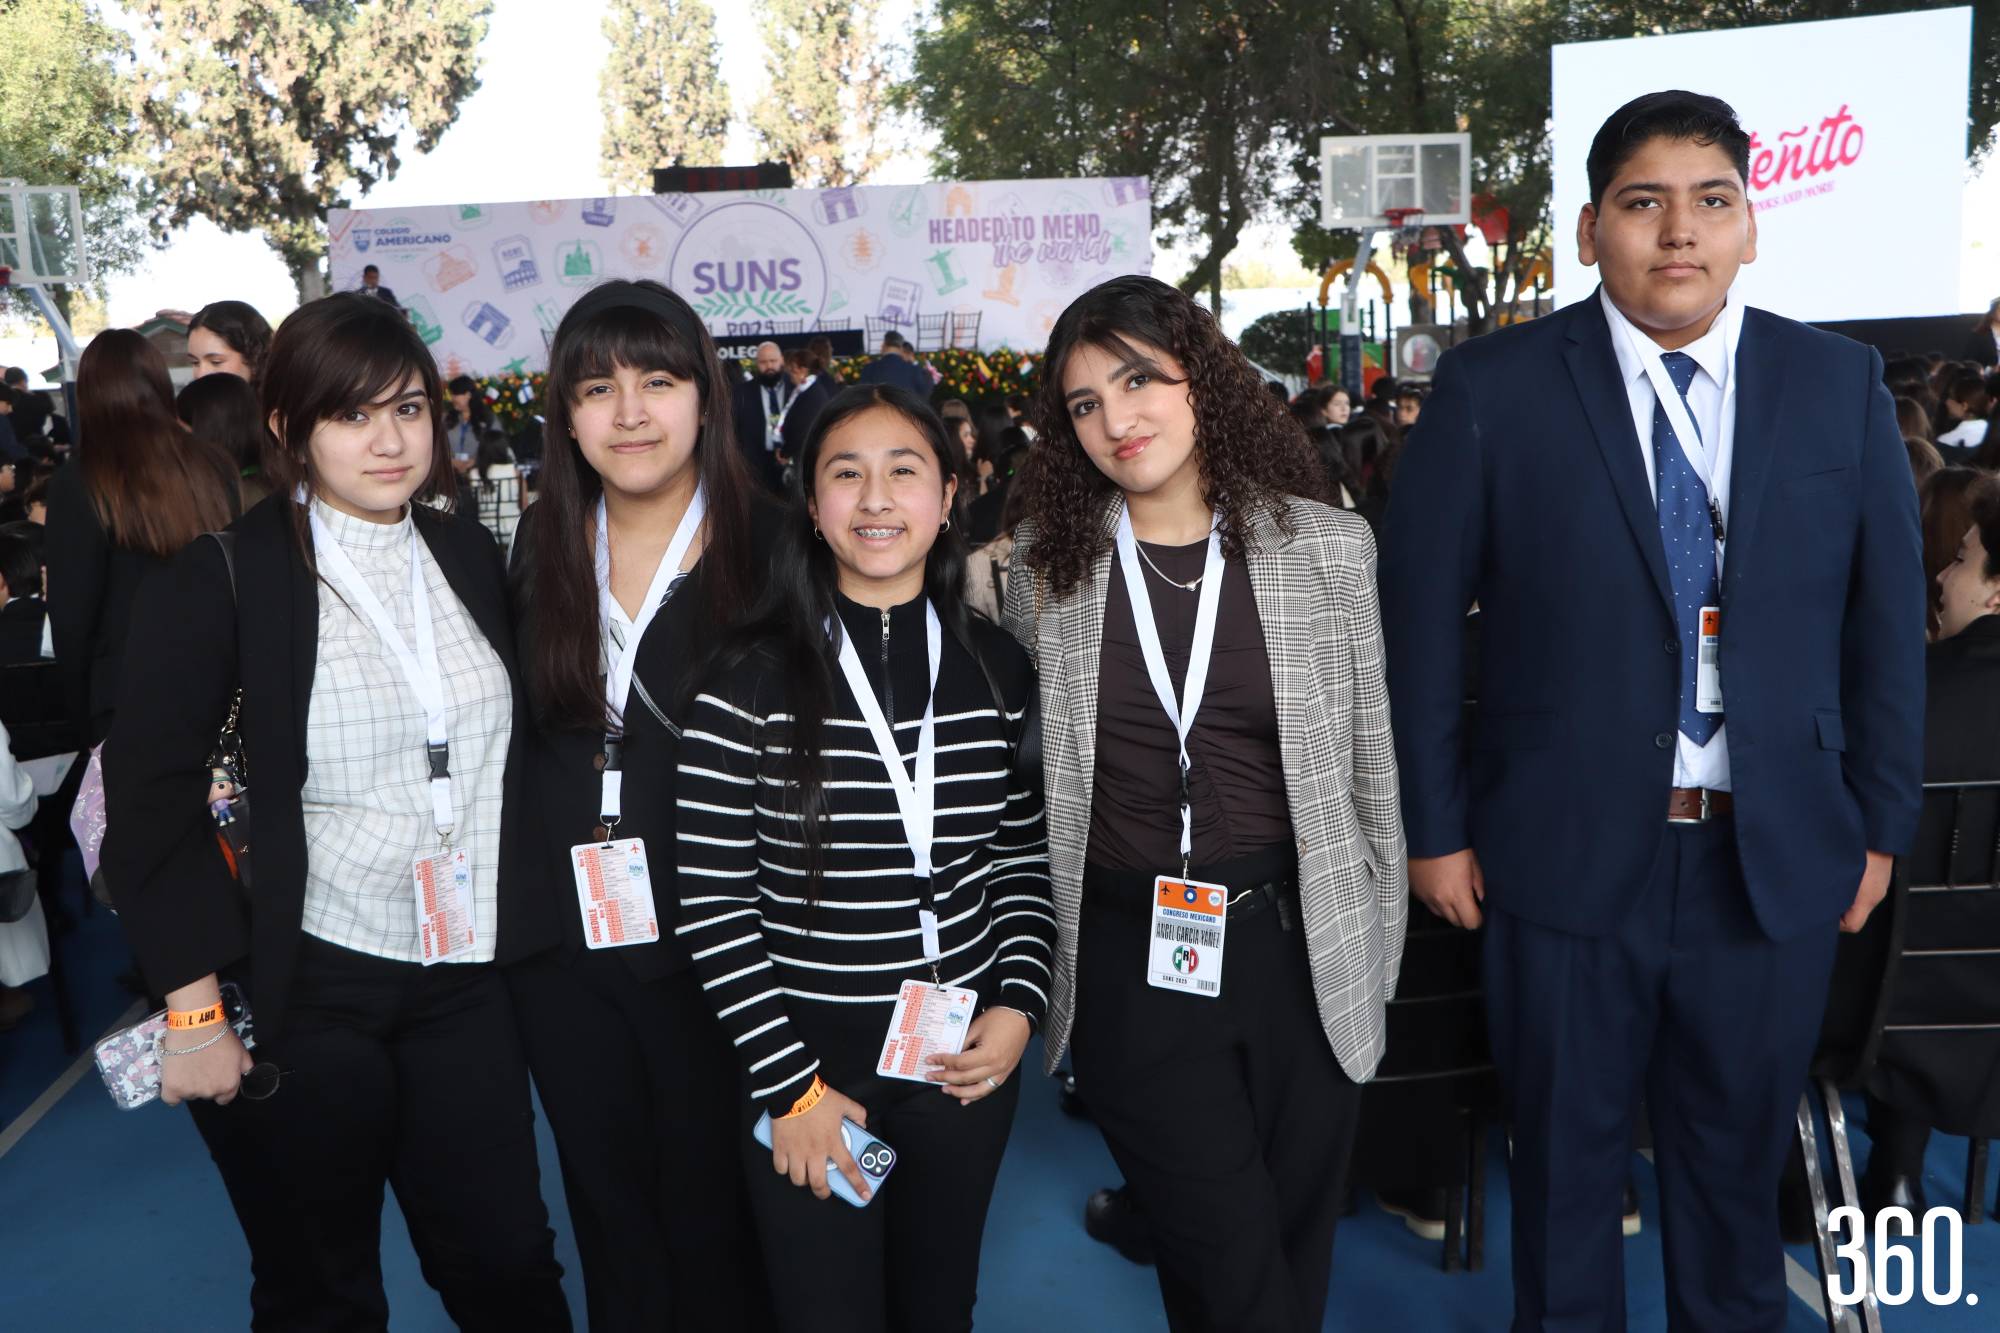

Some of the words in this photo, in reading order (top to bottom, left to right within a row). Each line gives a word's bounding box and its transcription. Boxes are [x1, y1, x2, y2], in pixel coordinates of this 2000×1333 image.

[374, 227, 410, 235] COLEGIO
[376, 234, 452, 246] AMERICANO
[928, 217, 1003, 244] HEADED
[1010, 216, 1035, 241] TO
[1042, 213, 1101, 239] MEND
[993, 233, 1034, 268] the
[1037, 230, 1111, 265] world
[693, 258, 802, 294] SUNS
[588, 908, 602, 943] SCHEDULE
[1162, 908, 1189, 919] CONGRESO
[1189, 913, 1216, 923] MEXICANO
[422, 923, 433, 959] SCHEDULE
[1175, 950, 1195, 967] PRI
[199, 1009, 216, 1024] DAY
